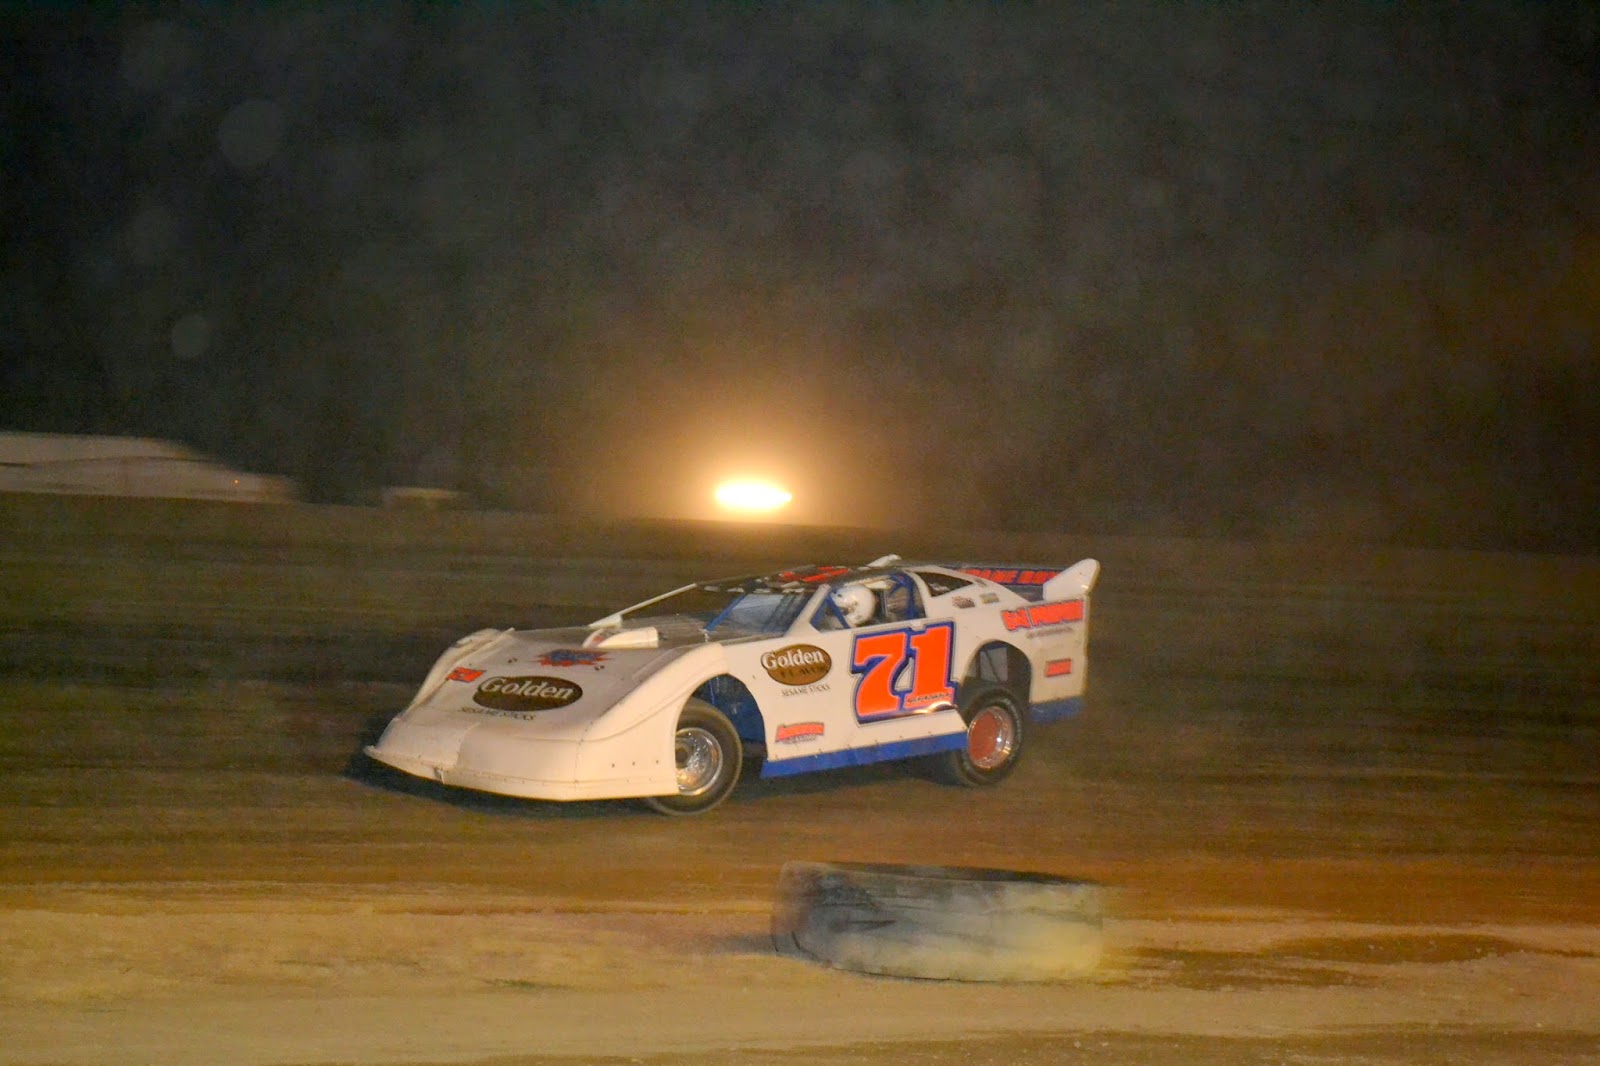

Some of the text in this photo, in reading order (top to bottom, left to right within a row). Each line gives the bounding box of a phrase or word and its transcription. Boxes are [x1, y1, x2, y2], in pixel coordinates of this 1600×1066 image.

[761, 648, 826, 671] Golden
[848, 621, 958, 724] 71
[480, 677, 574, 699] Golden
